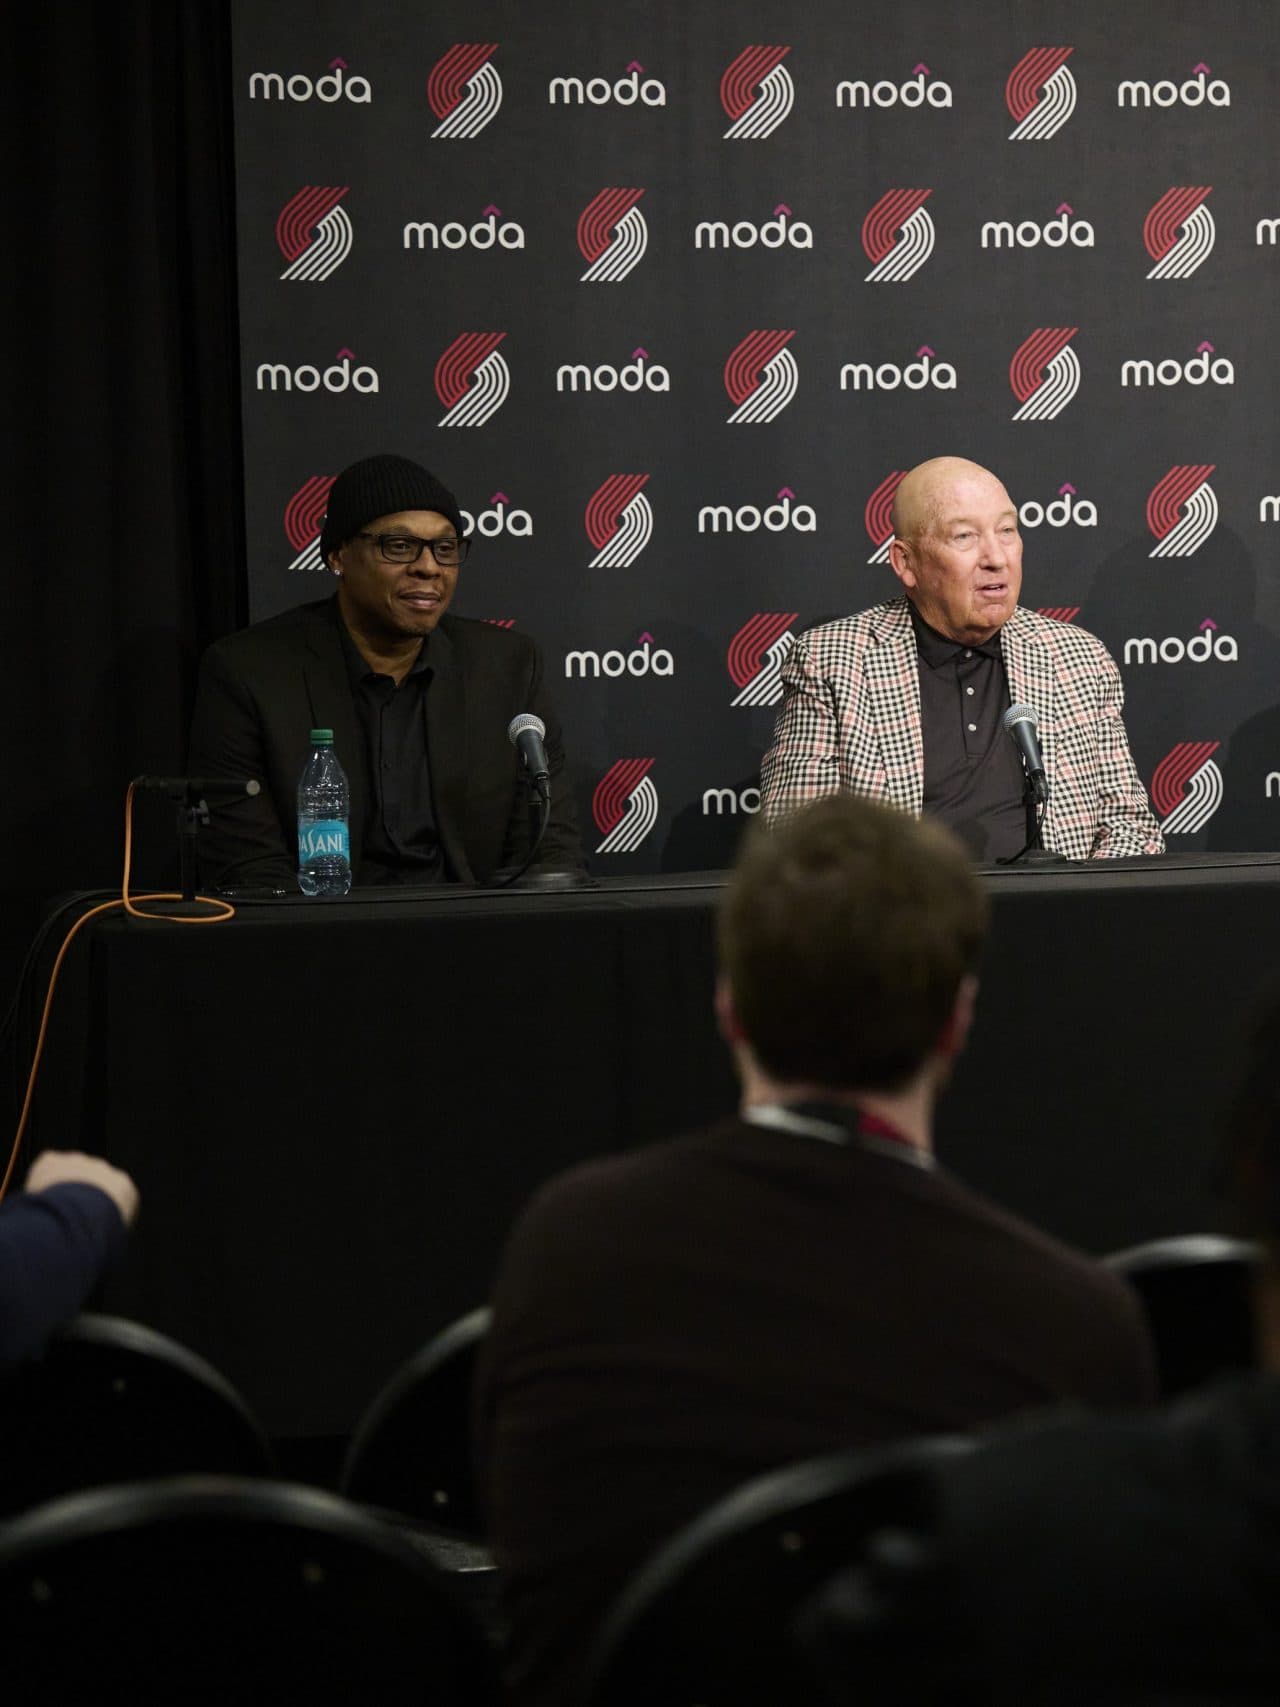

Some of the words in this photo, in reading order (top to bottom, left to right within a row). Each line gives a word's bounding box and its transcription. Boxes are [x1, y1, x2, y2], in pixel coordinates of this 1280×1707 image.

[249, 68, 372, 103] moda
[548, 71, 666, 107] moda
[835, 73, 953, 108] moda
[1117, 72, 1231, 108] moda
[403, 214, 525, 250] moda
[694, 213, 814, 249] moda
[980, 212, 1095, 249] moda
[256, 358, 379, 393] moda
[556, 357, 670, 392] moda
[840, 354, 957, 391] moda
[1120, 350, 1235, 387] moda
[458, 502, 533, 537] oda
[698, 497, 817, 533] moda
[1018, 492, 1098, 528] oda
[565, 642, 674, 678] moda
[1124, 628, 1239, 665] moda
[702, 787, 761, 816] mo
